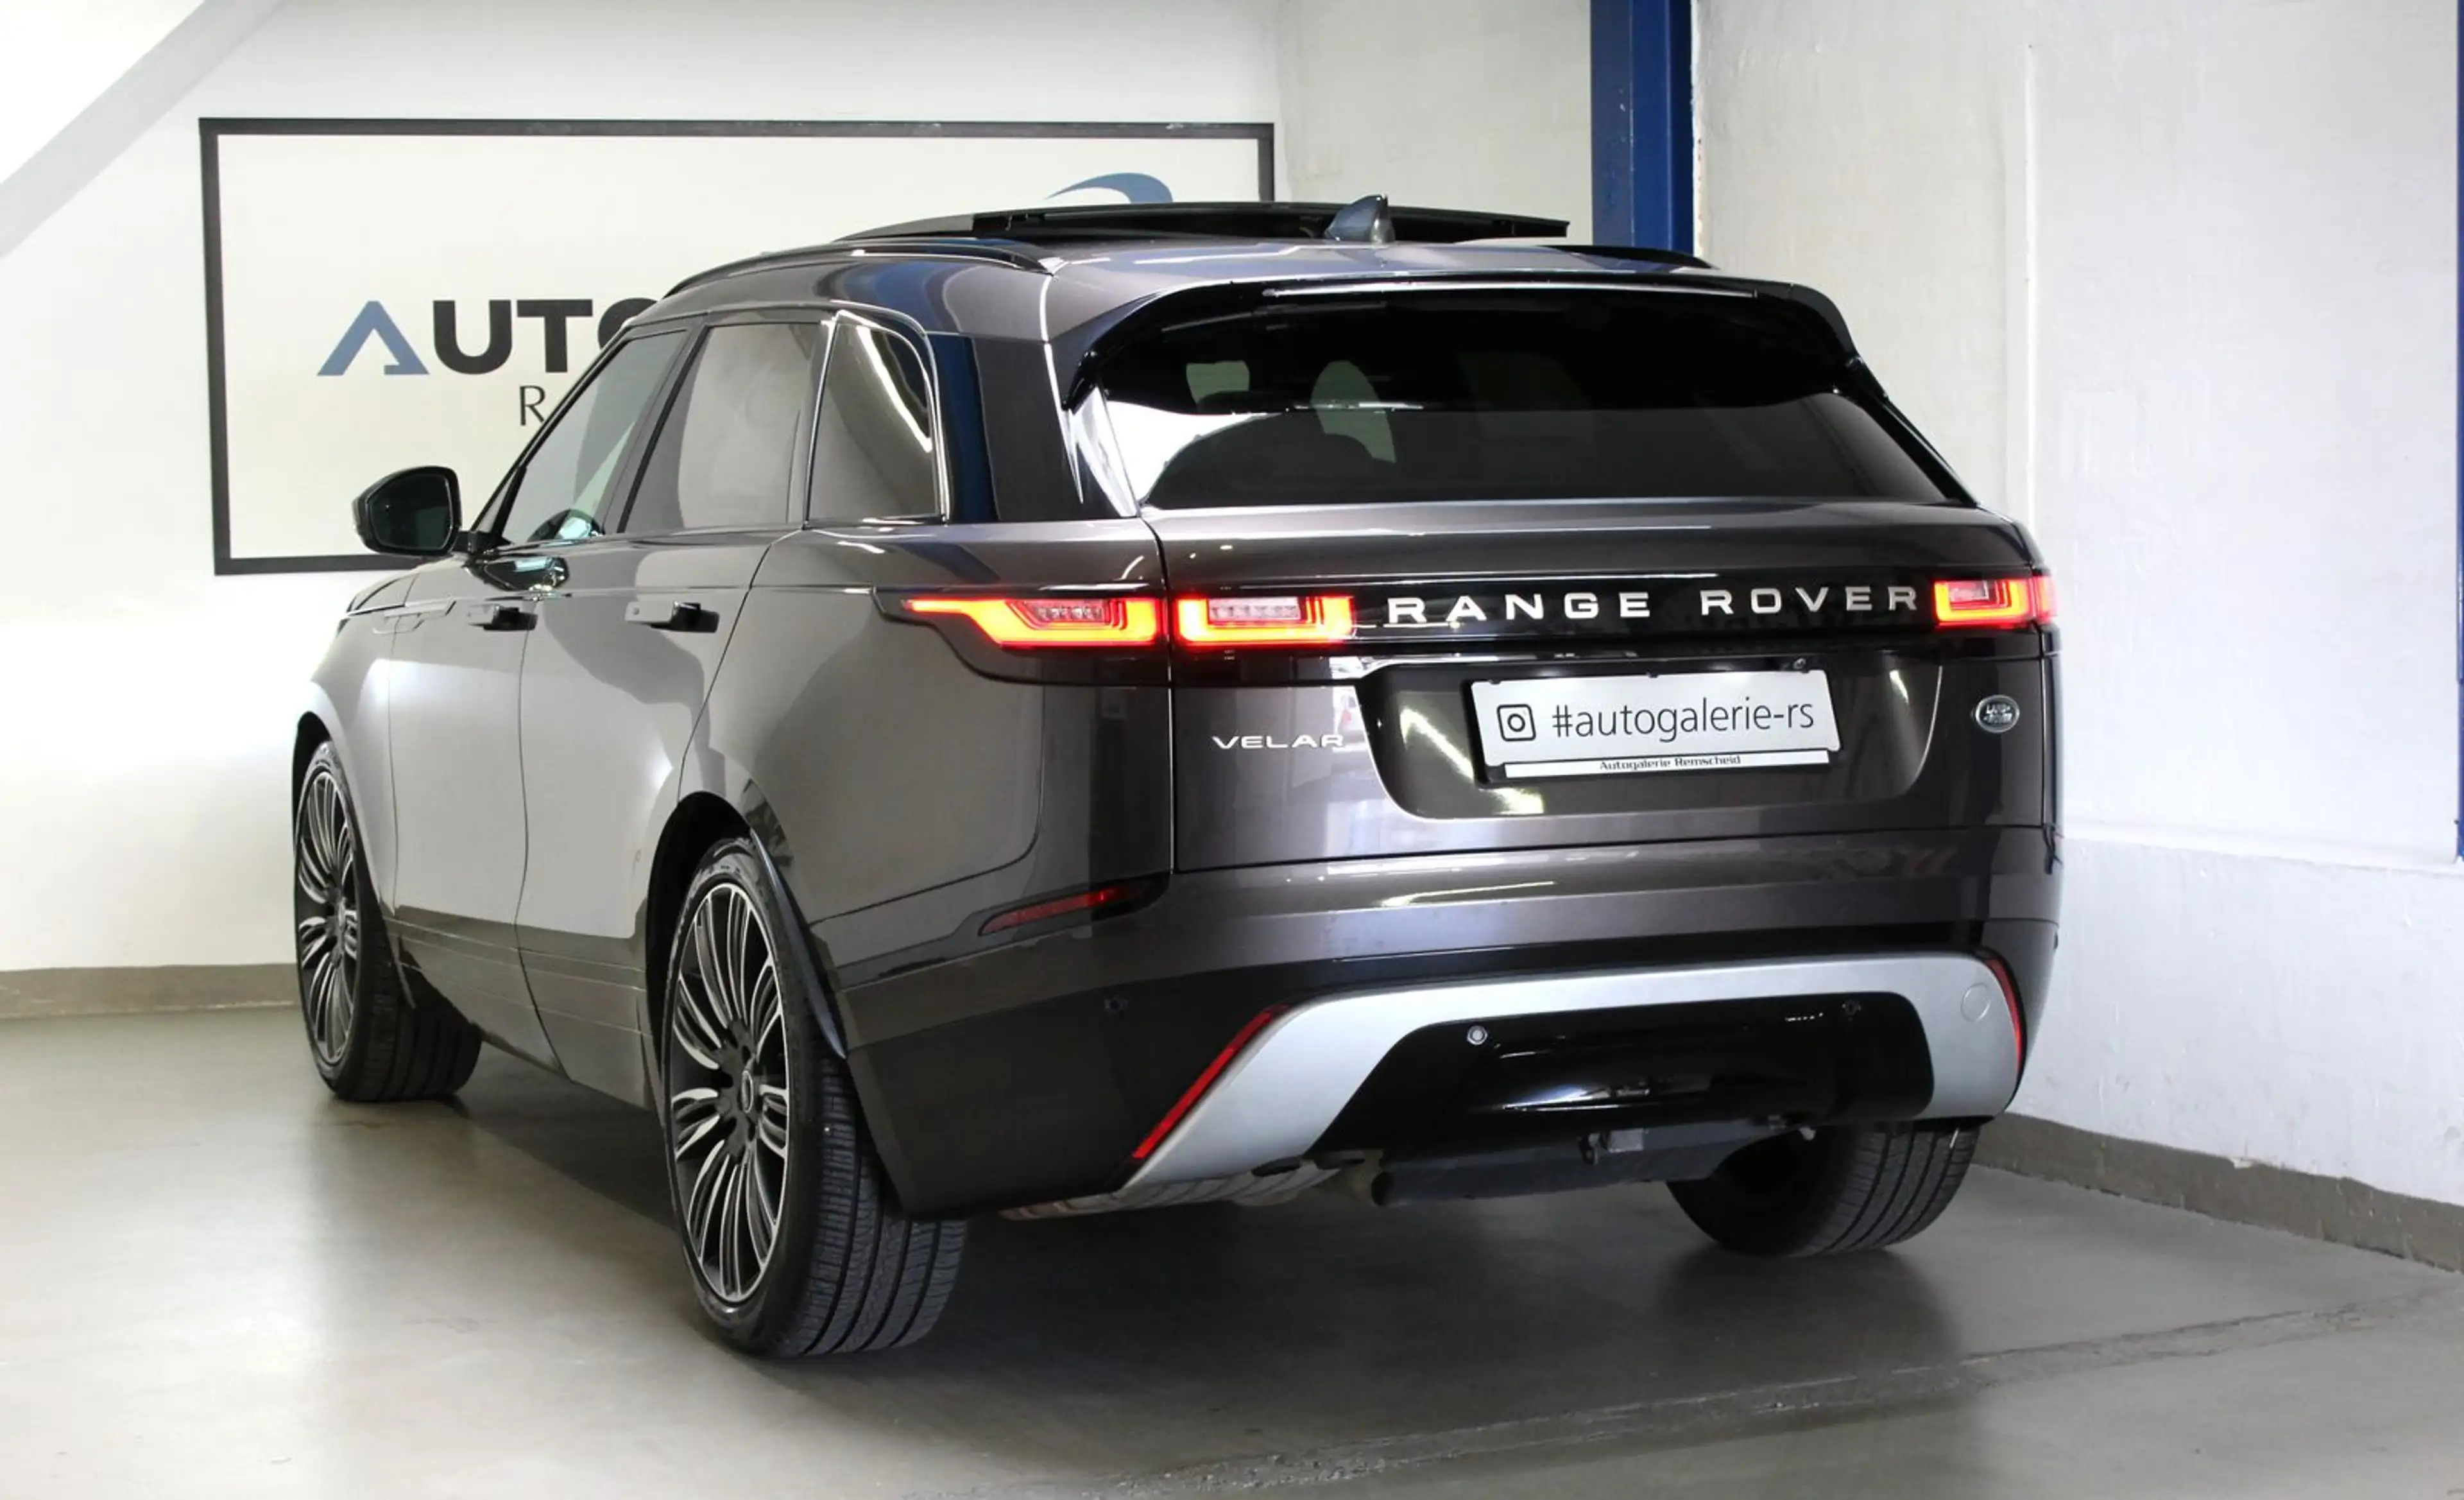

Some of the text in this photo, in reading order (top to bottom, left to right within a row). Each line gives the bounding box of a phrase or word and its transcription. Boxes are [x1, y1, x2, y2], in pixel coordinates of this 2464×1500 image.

[1387, 586, 1917, 623] RANGE ROVER
[1552, 697, 1815, 743] #autogalerie-rs
[1212, 735, 1344, 749] VELAR
[1600, 755, 1741, 771] Autogalerie Remscheid
